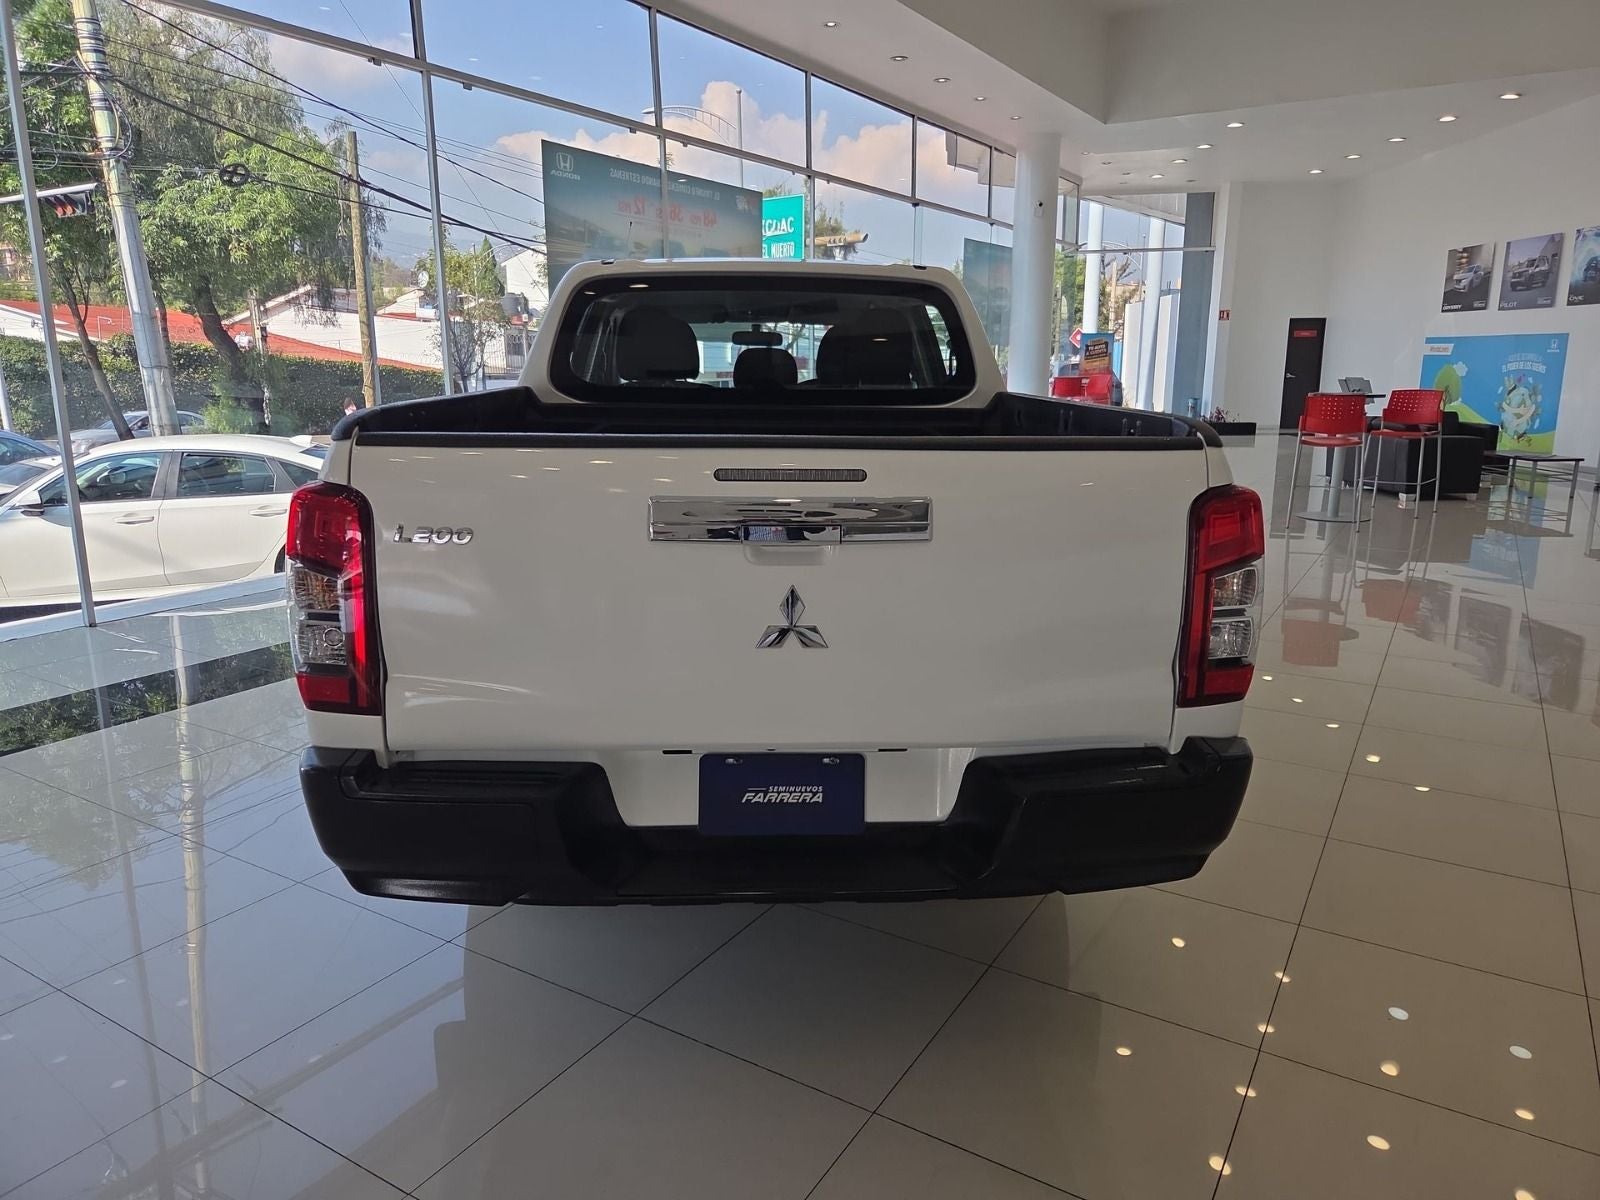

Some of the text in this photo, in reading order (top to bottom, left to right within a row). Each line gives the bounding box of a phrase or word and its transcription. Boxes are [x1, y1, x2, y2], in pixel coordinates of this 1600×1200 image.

[771, 241, 795, 258] MUERTO
[393, 524, 474, 546] L200
[741, 792, 823, 804] FARRERA
